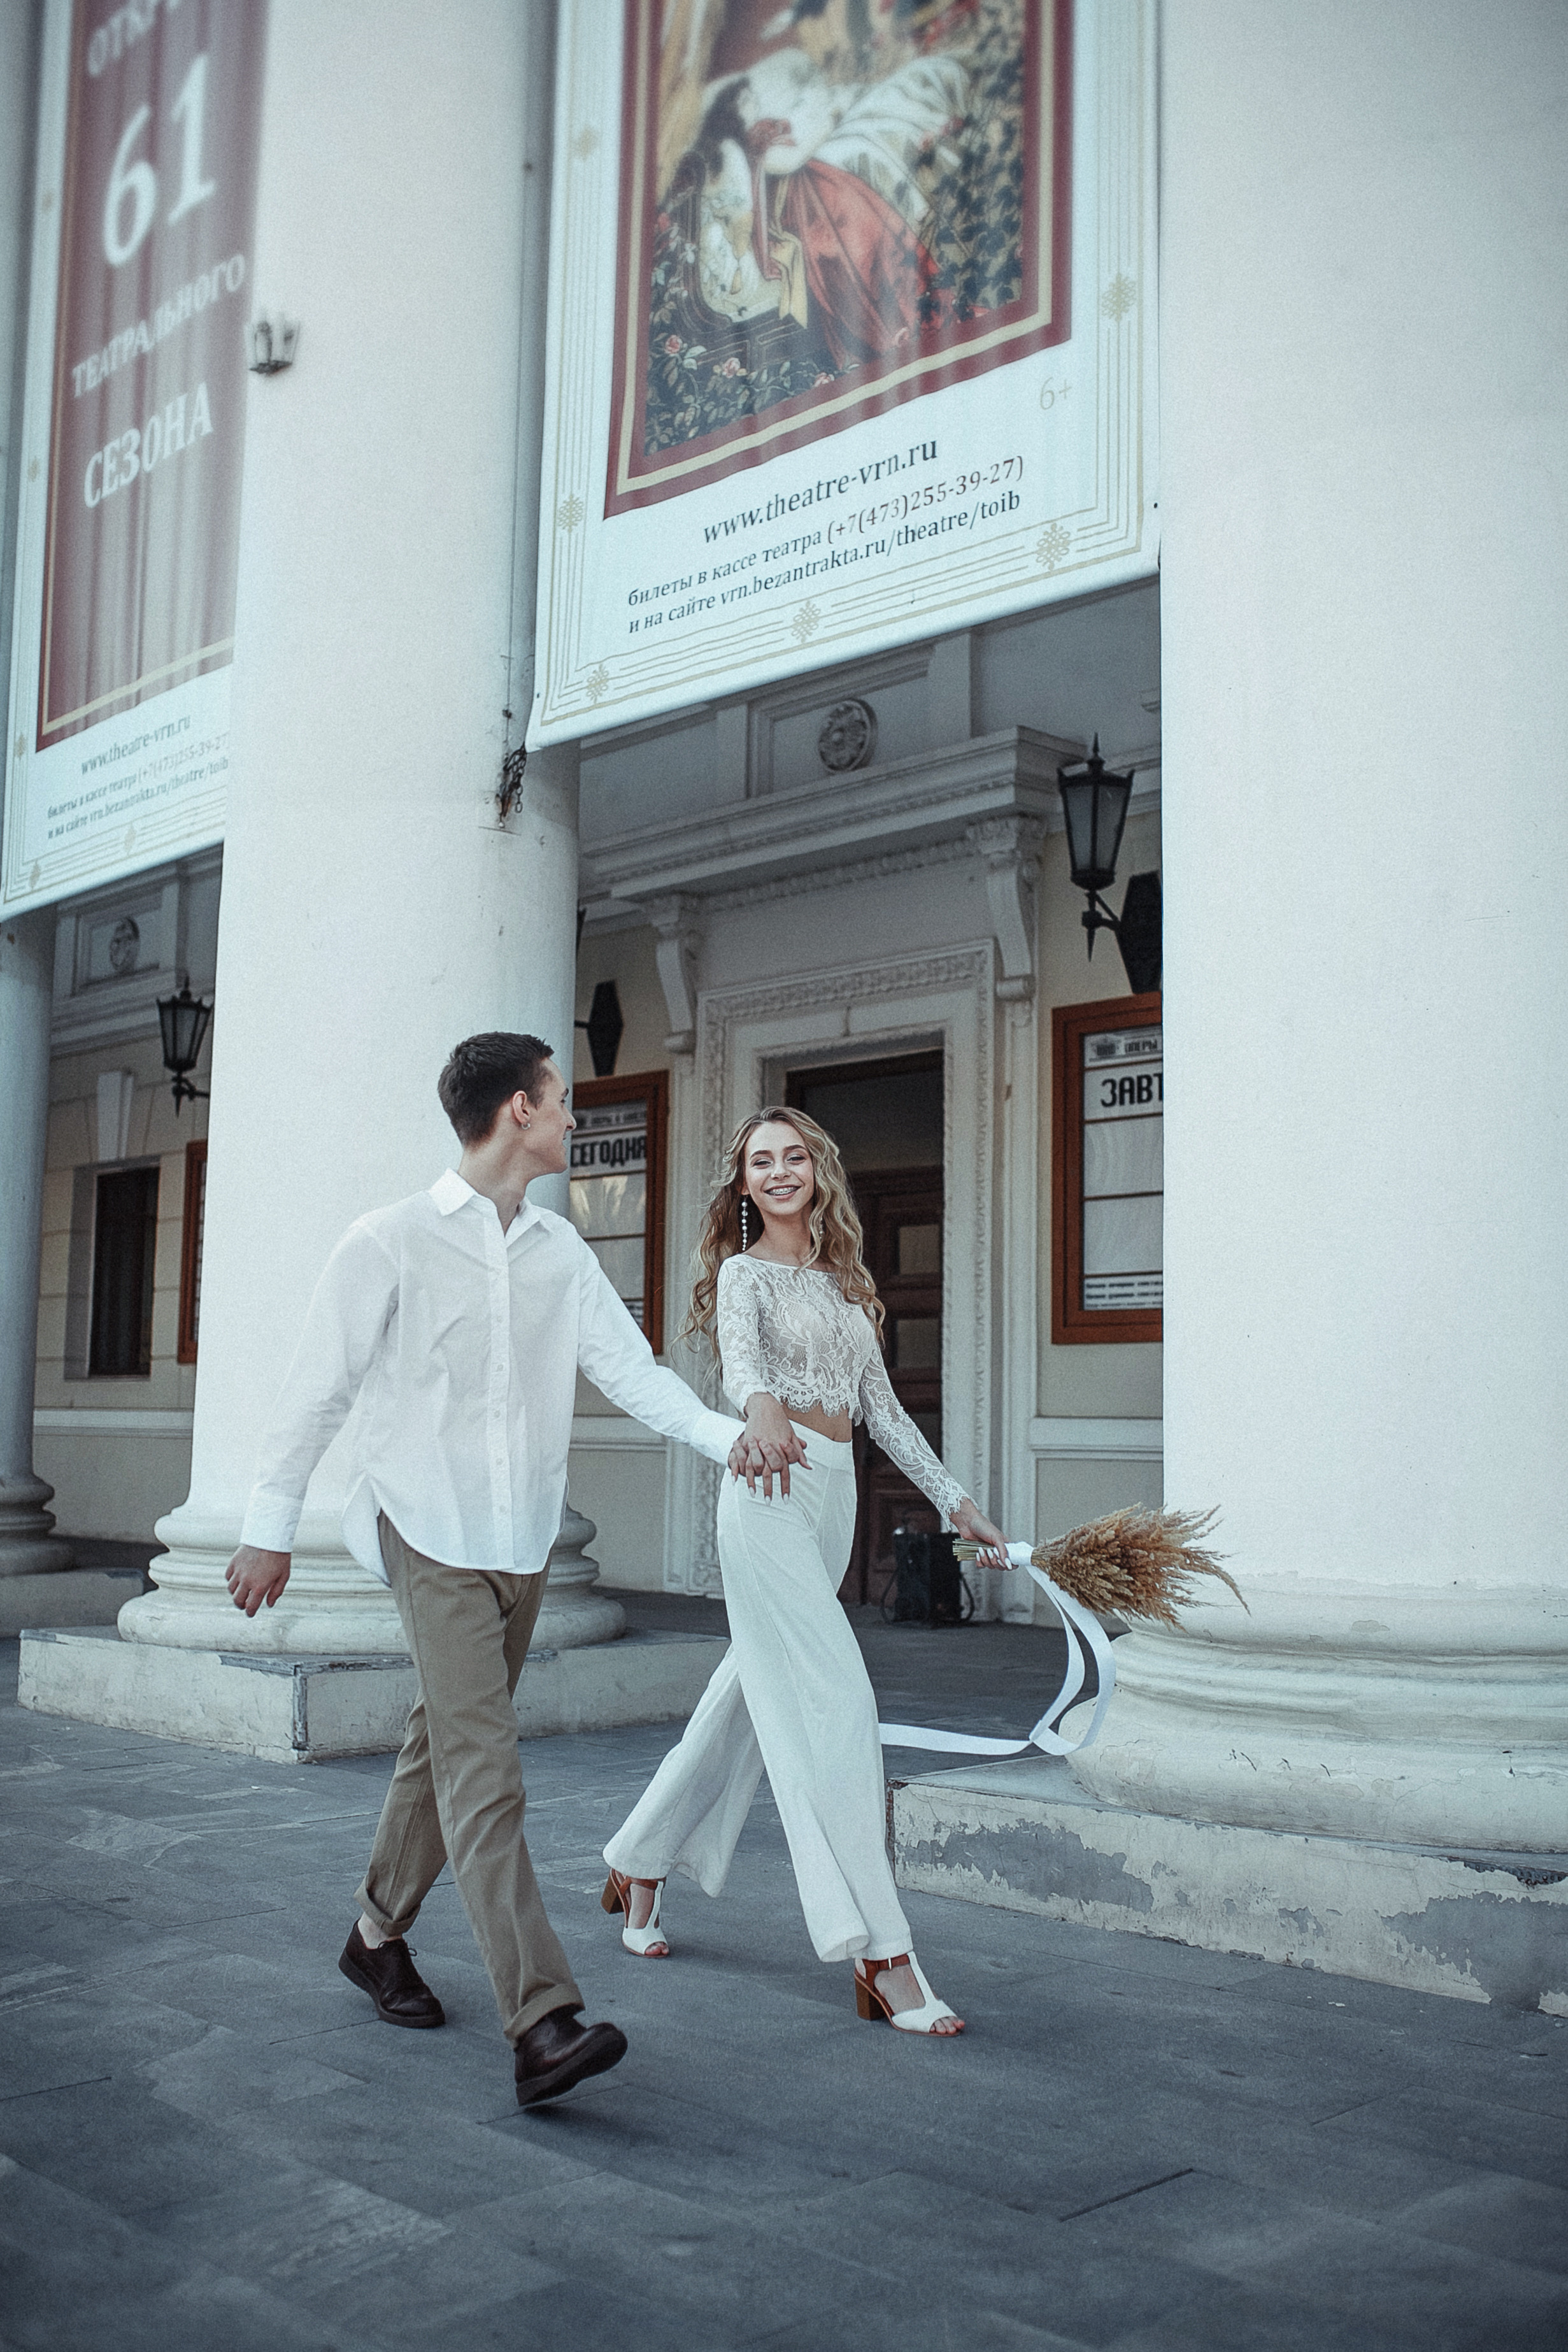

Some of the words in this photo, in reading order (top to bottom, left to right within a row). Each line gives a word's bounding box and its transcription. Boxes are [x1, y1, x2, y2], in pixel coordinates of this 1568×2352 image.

[88, 0, 180, 75] ОТК
[104, 53, 216, 268] 61
[72, 254, 245, 398] ТЕАТРАЛЬНОГО
[1040, 376, 1072, 410] 6+
[84, 382, 214, 508] СЕЗОНА
[703, 440, 937, 543] www.theatre-vrn.ru
[629, 575, 692, 606] билеты
[698, 571, 707, 585] в
[712, 553, 757, 580] кассе
[762, 531, 822, 562] театра
[828, 456, 1023, 544] (+7(473)255-39-27)
[629, 620, 639, 634] и
[644, 612, 662, 629] на
[669, 596, 715, 621] сайте
[721, 490, 1020, 604] vrn.bezantrakta.ru/theatre/toib
[82, 715, 190, 775] www.theatre-vrn.ru
[1101, 1073, 1163, 1108] ЗАВТ
[571, 1136, 647, 1167] СЕГОДНЯ
